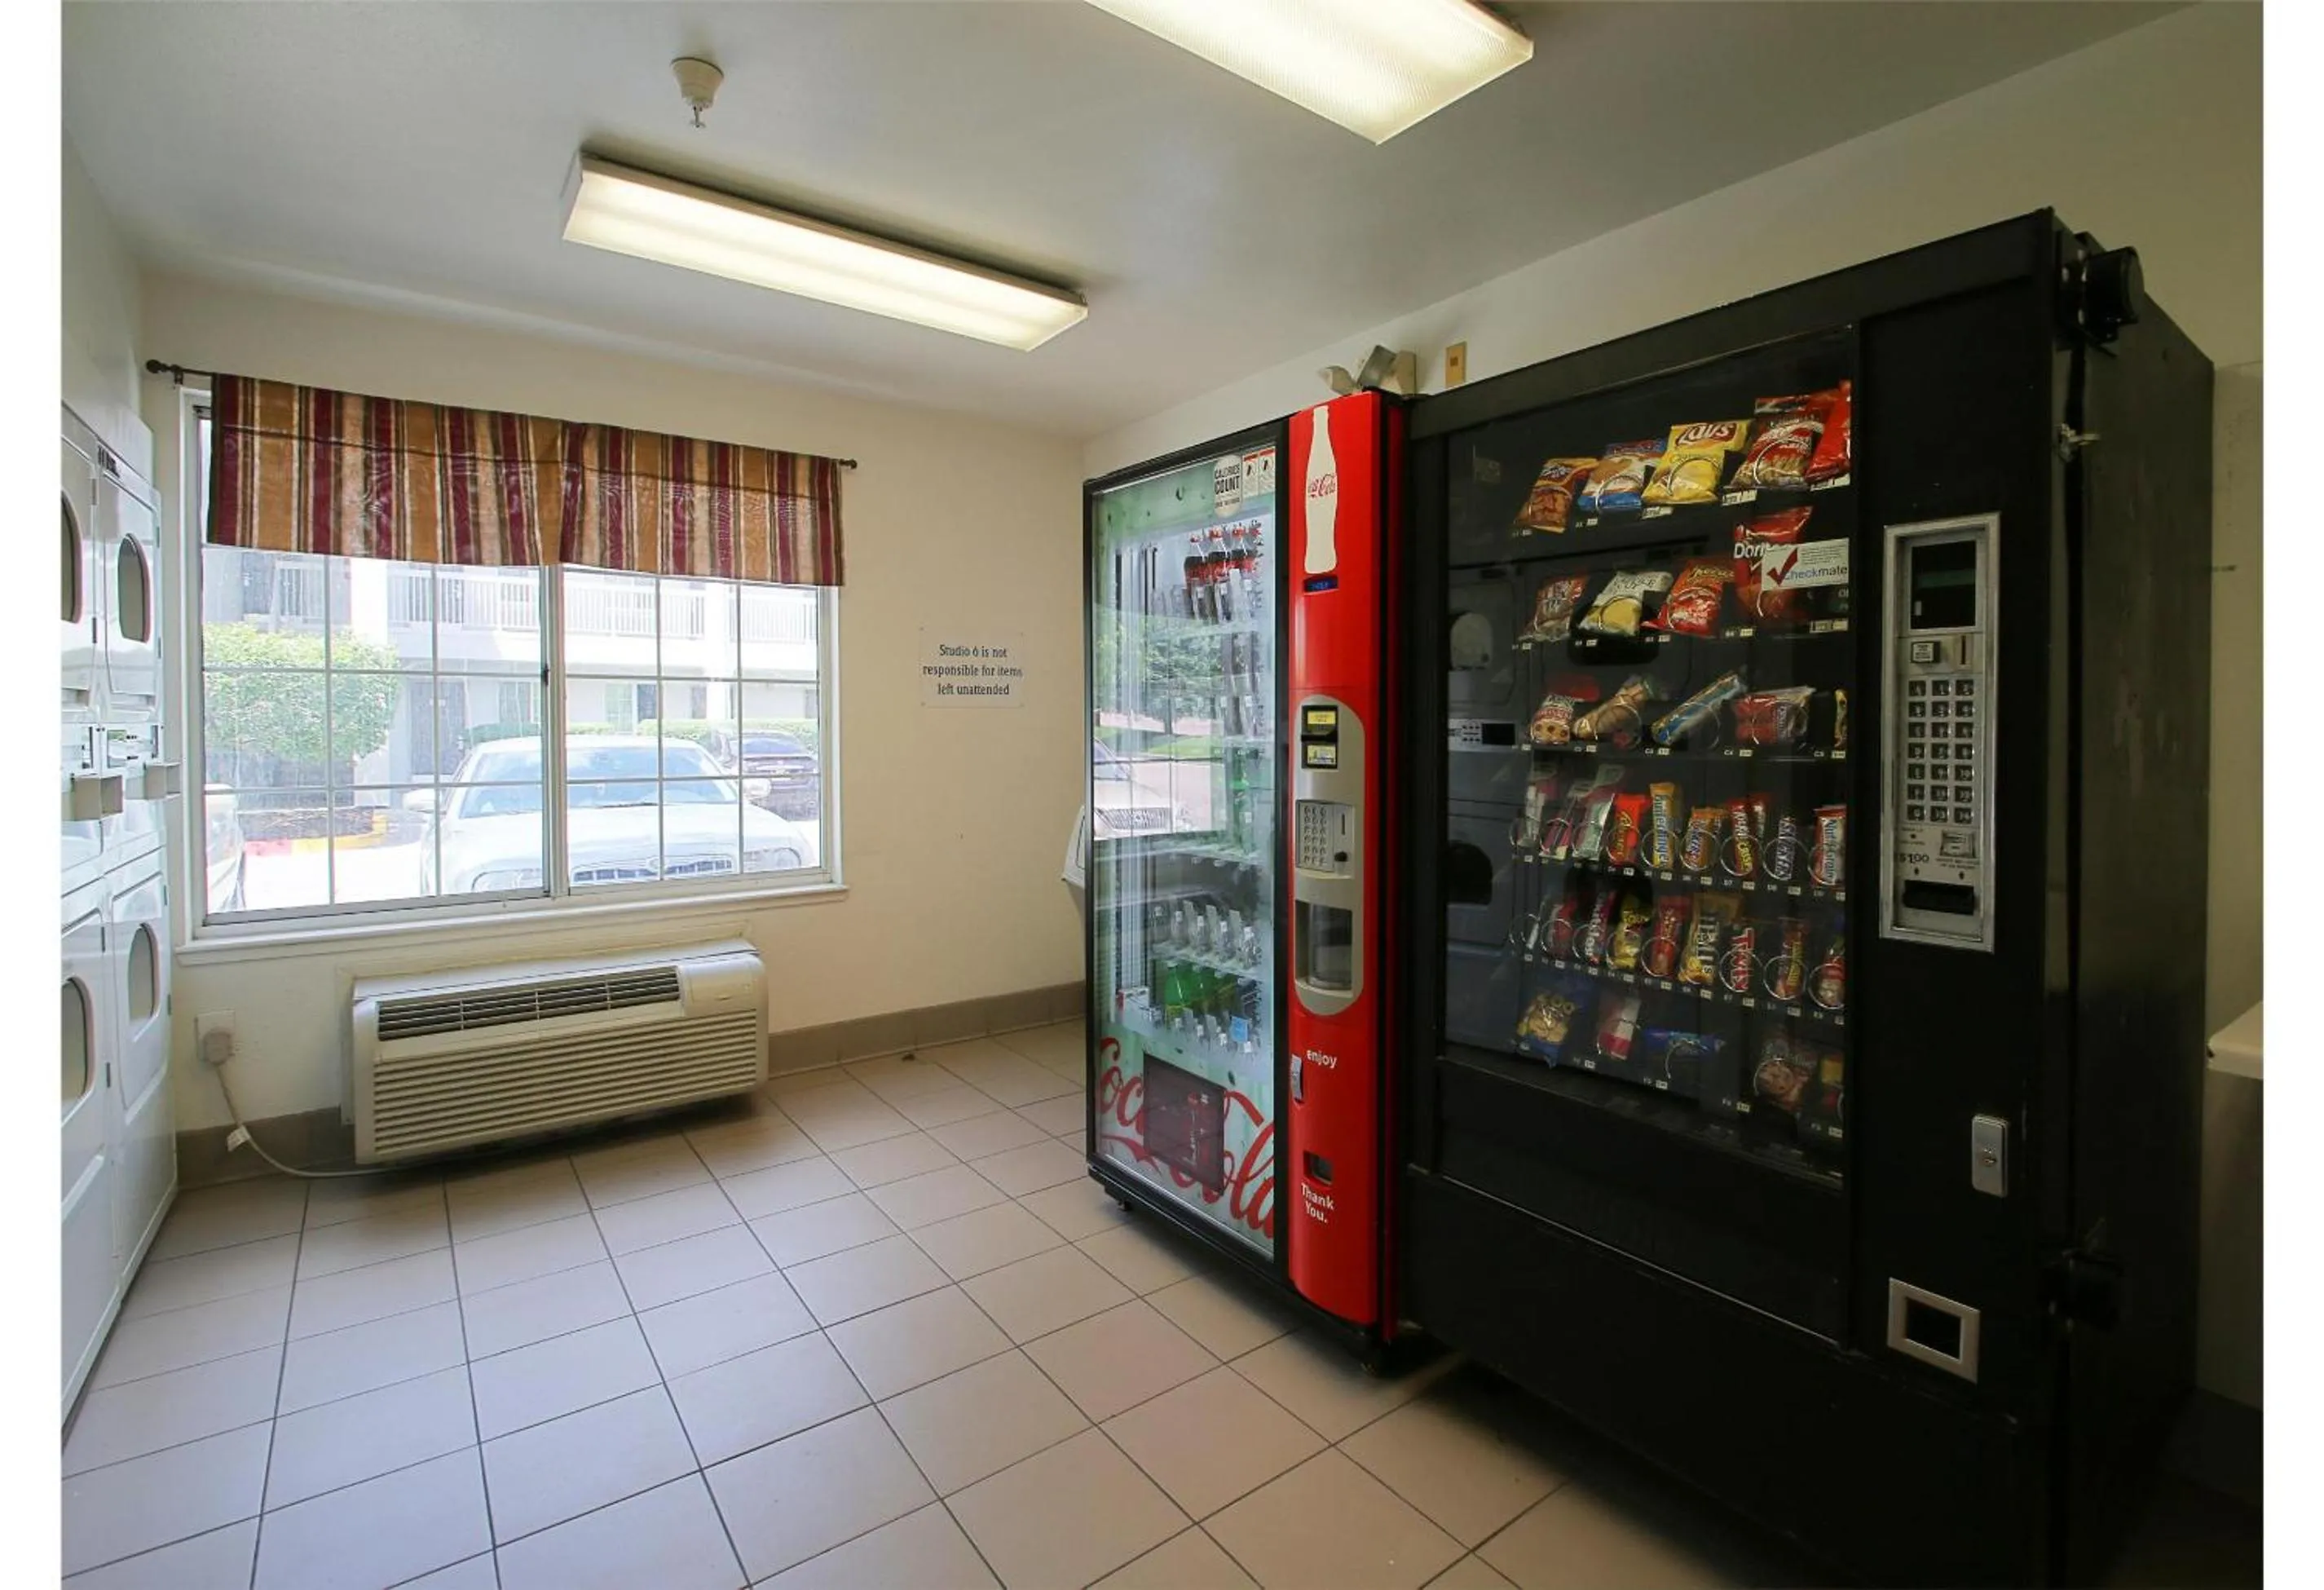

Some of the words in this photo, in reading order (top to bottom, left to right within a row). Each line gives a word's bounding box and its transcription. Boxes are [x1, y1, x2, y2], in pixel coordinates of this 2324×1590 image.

[1215, 475, 1240, 495] COUNT
[1734, 541, 1767, 559] Dori
[1784, 566, 1848, 581] checkmate
[939, 644, 970, 656] Studio
[972, 646, 979, 657] 6
[981, 646, 990, 657] is
[992, 647, 1008, 658] not
[923, 665, 978, 678] responsible
[981, 665, 994, 676] for
[998, 665, 1024, 678] items
[937, 682, 954, 695] left
[957, 683, 1010, 695] unattended
[1307, 1049, 1337, 1069] enjoy
[1302, 1183, 1334, 1210] Thank
[1305, 1200, 1328, 1223] You.
